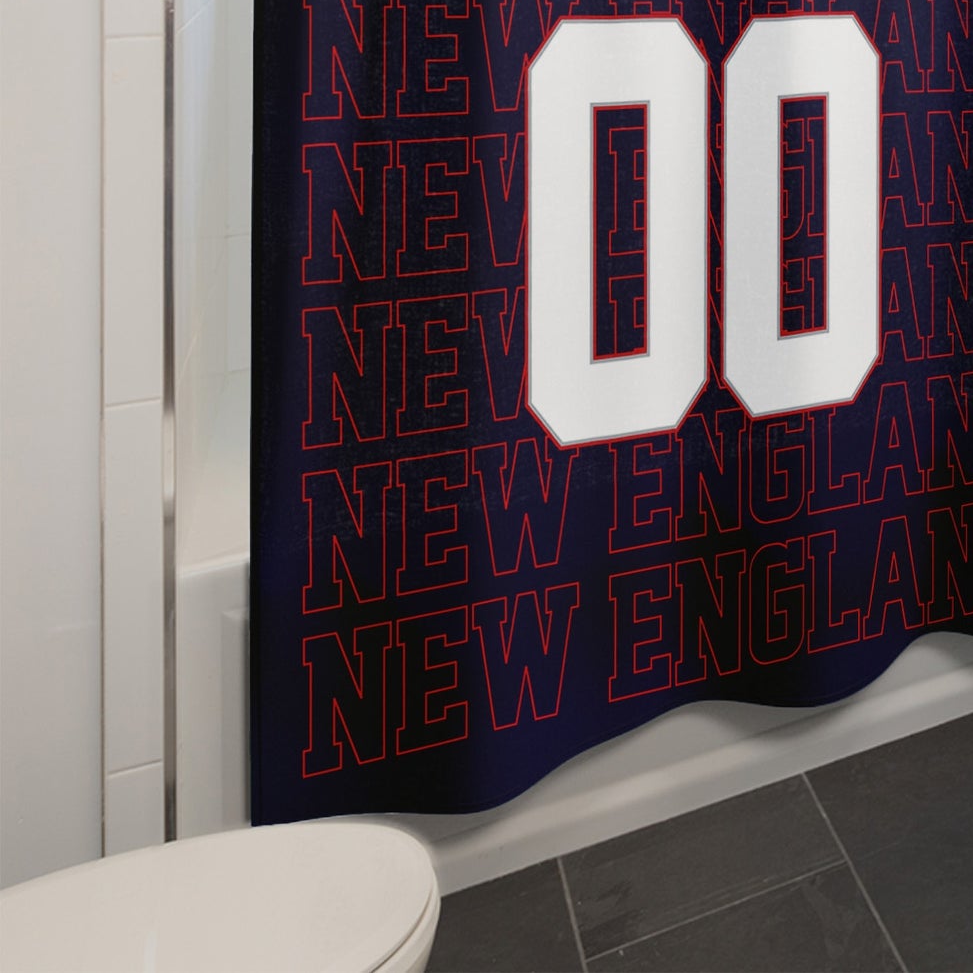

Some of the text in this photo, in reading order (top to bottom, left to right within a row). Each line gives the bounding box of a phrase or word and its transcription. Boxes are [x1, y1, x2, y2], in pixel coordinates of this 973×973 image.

[525, 11, 882, 450] 00
[303, 438, 579, 614] NEW
[303, 582, 579, 778] NEW
